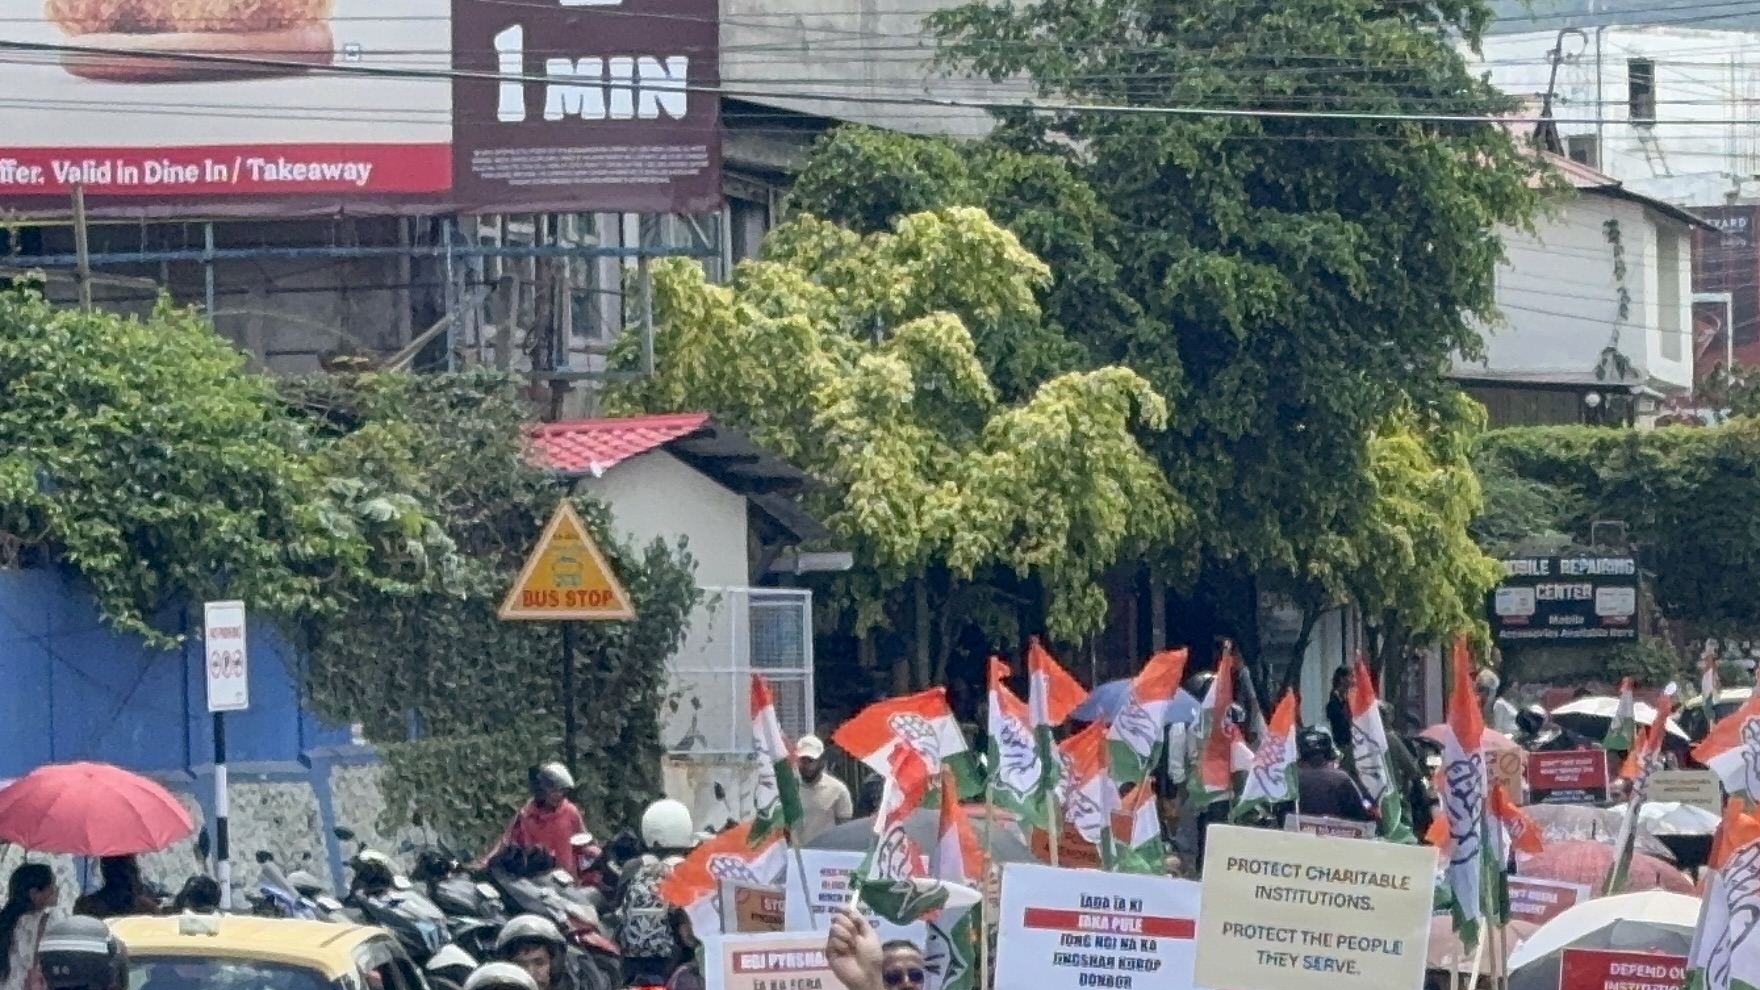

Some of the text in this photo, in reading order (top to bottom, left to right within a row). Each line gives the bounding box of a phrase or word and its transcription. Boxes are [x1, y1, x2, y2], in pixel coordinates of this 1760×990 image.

[494, 24, 689, 122] 1 MIN
[0, 158, 44, 184] ffer.
[51, 159, 111, 184] Valid
[144, 160, 199, 184] Dine
[204, 158, 227, 182] In
[231, 156, 241, 185] /
[247, 157, 372, 186] Takeaway
[1503, 557, 1635, 576] OBILE REPAIRING
[522, 590, 613, 608] BUS STOP
[1536, 583, 1592, 600] CENTER
[1227, 856, 1411, 891] PROTECT CHARITABLE
[764, 898, 786, 912] STO
[1255, 885, 1375, 911] INSTITUTIONS.
[1222, 921, 1403, 956] PROTECT THE PEOPLE
[768, 951, 828, 969] PYRSHA
[1257, 950, 1361, 976] THEY SERVE.
[1610, 962, 1688, 980] DEFEND OU
